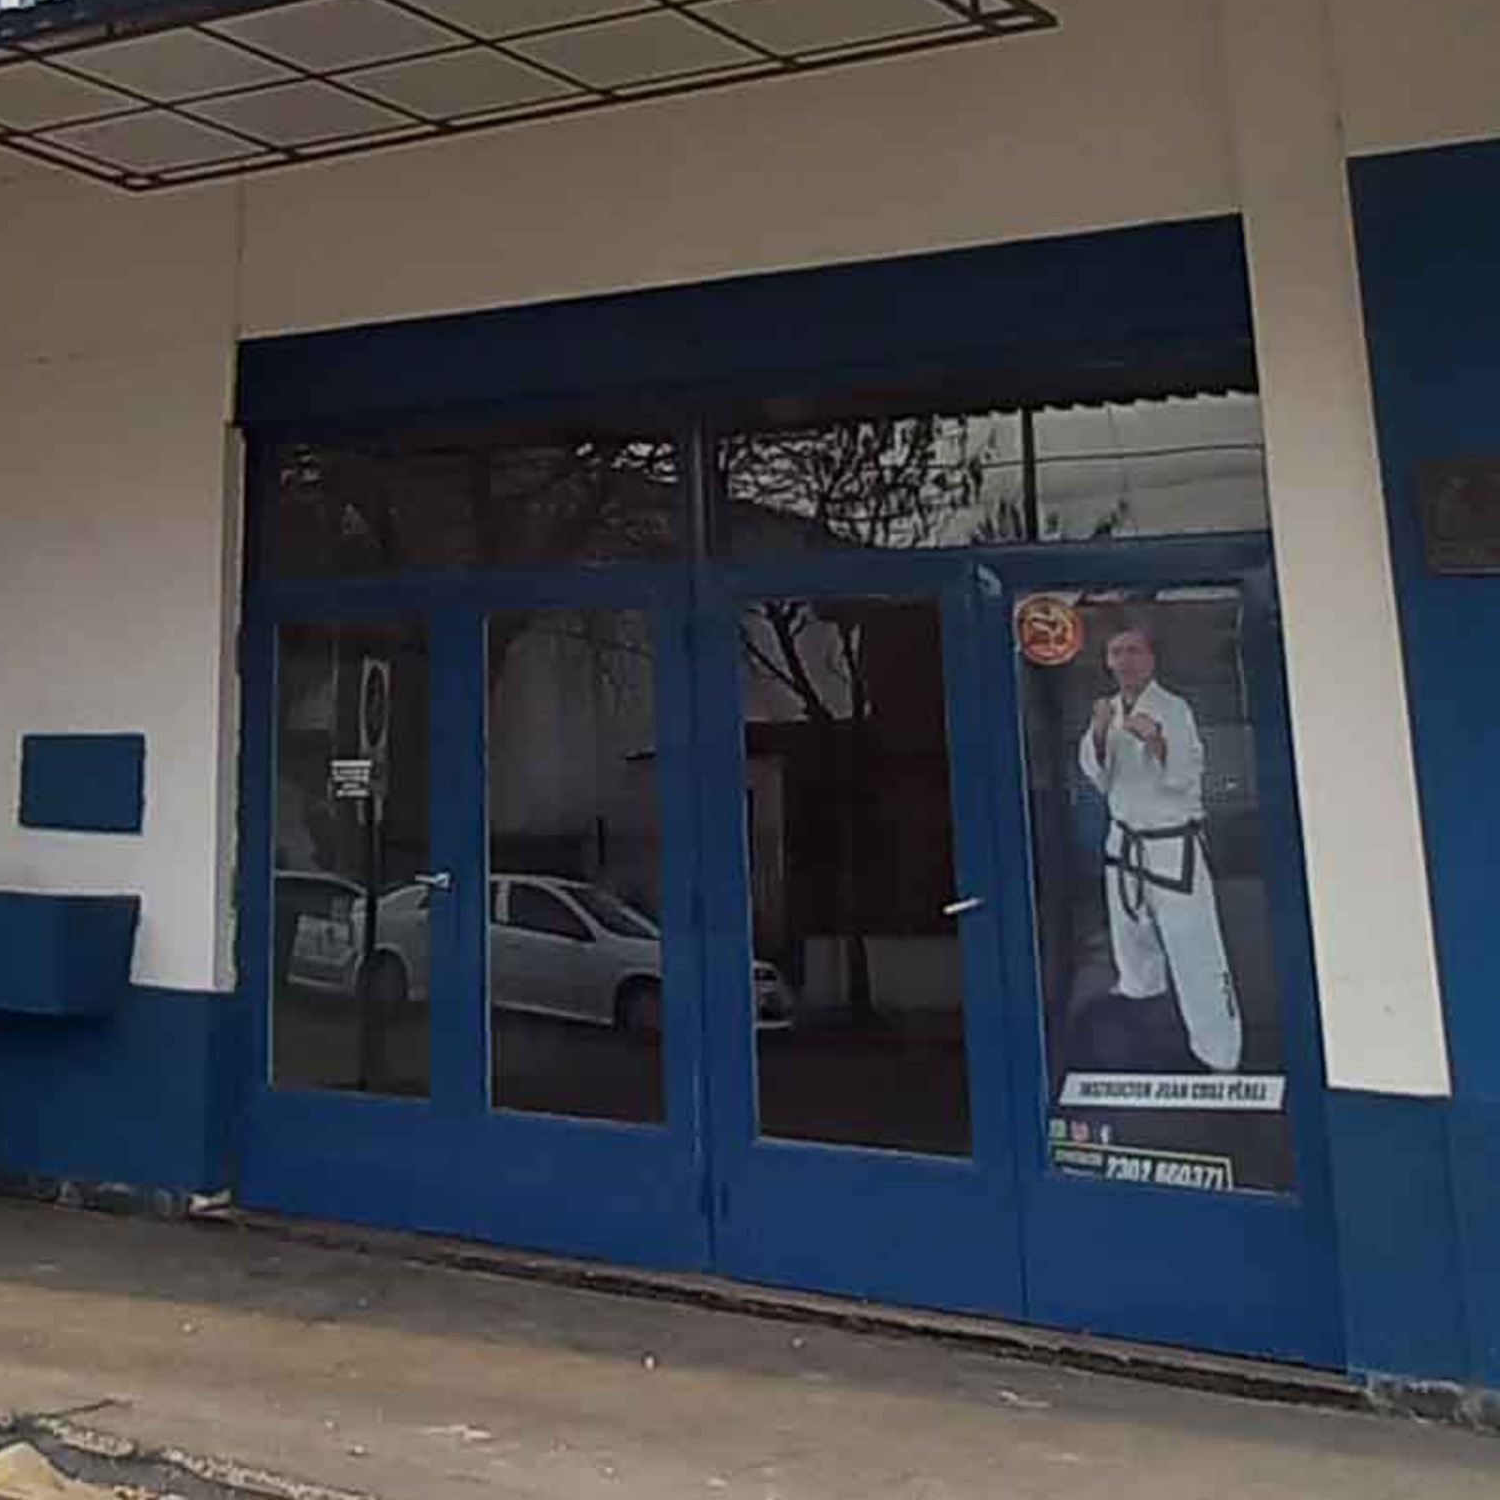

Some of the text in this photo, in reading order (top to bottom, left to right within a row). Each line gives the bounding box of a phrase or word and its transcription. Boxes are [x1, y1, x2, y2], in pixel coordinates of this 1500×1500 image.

[1079, 1080, 1153, 1098] INSTRUCTOR
[1155, 1081, 1188, 1100] JUAN
[1190, 1082, 1225, 1100] CRUZ
